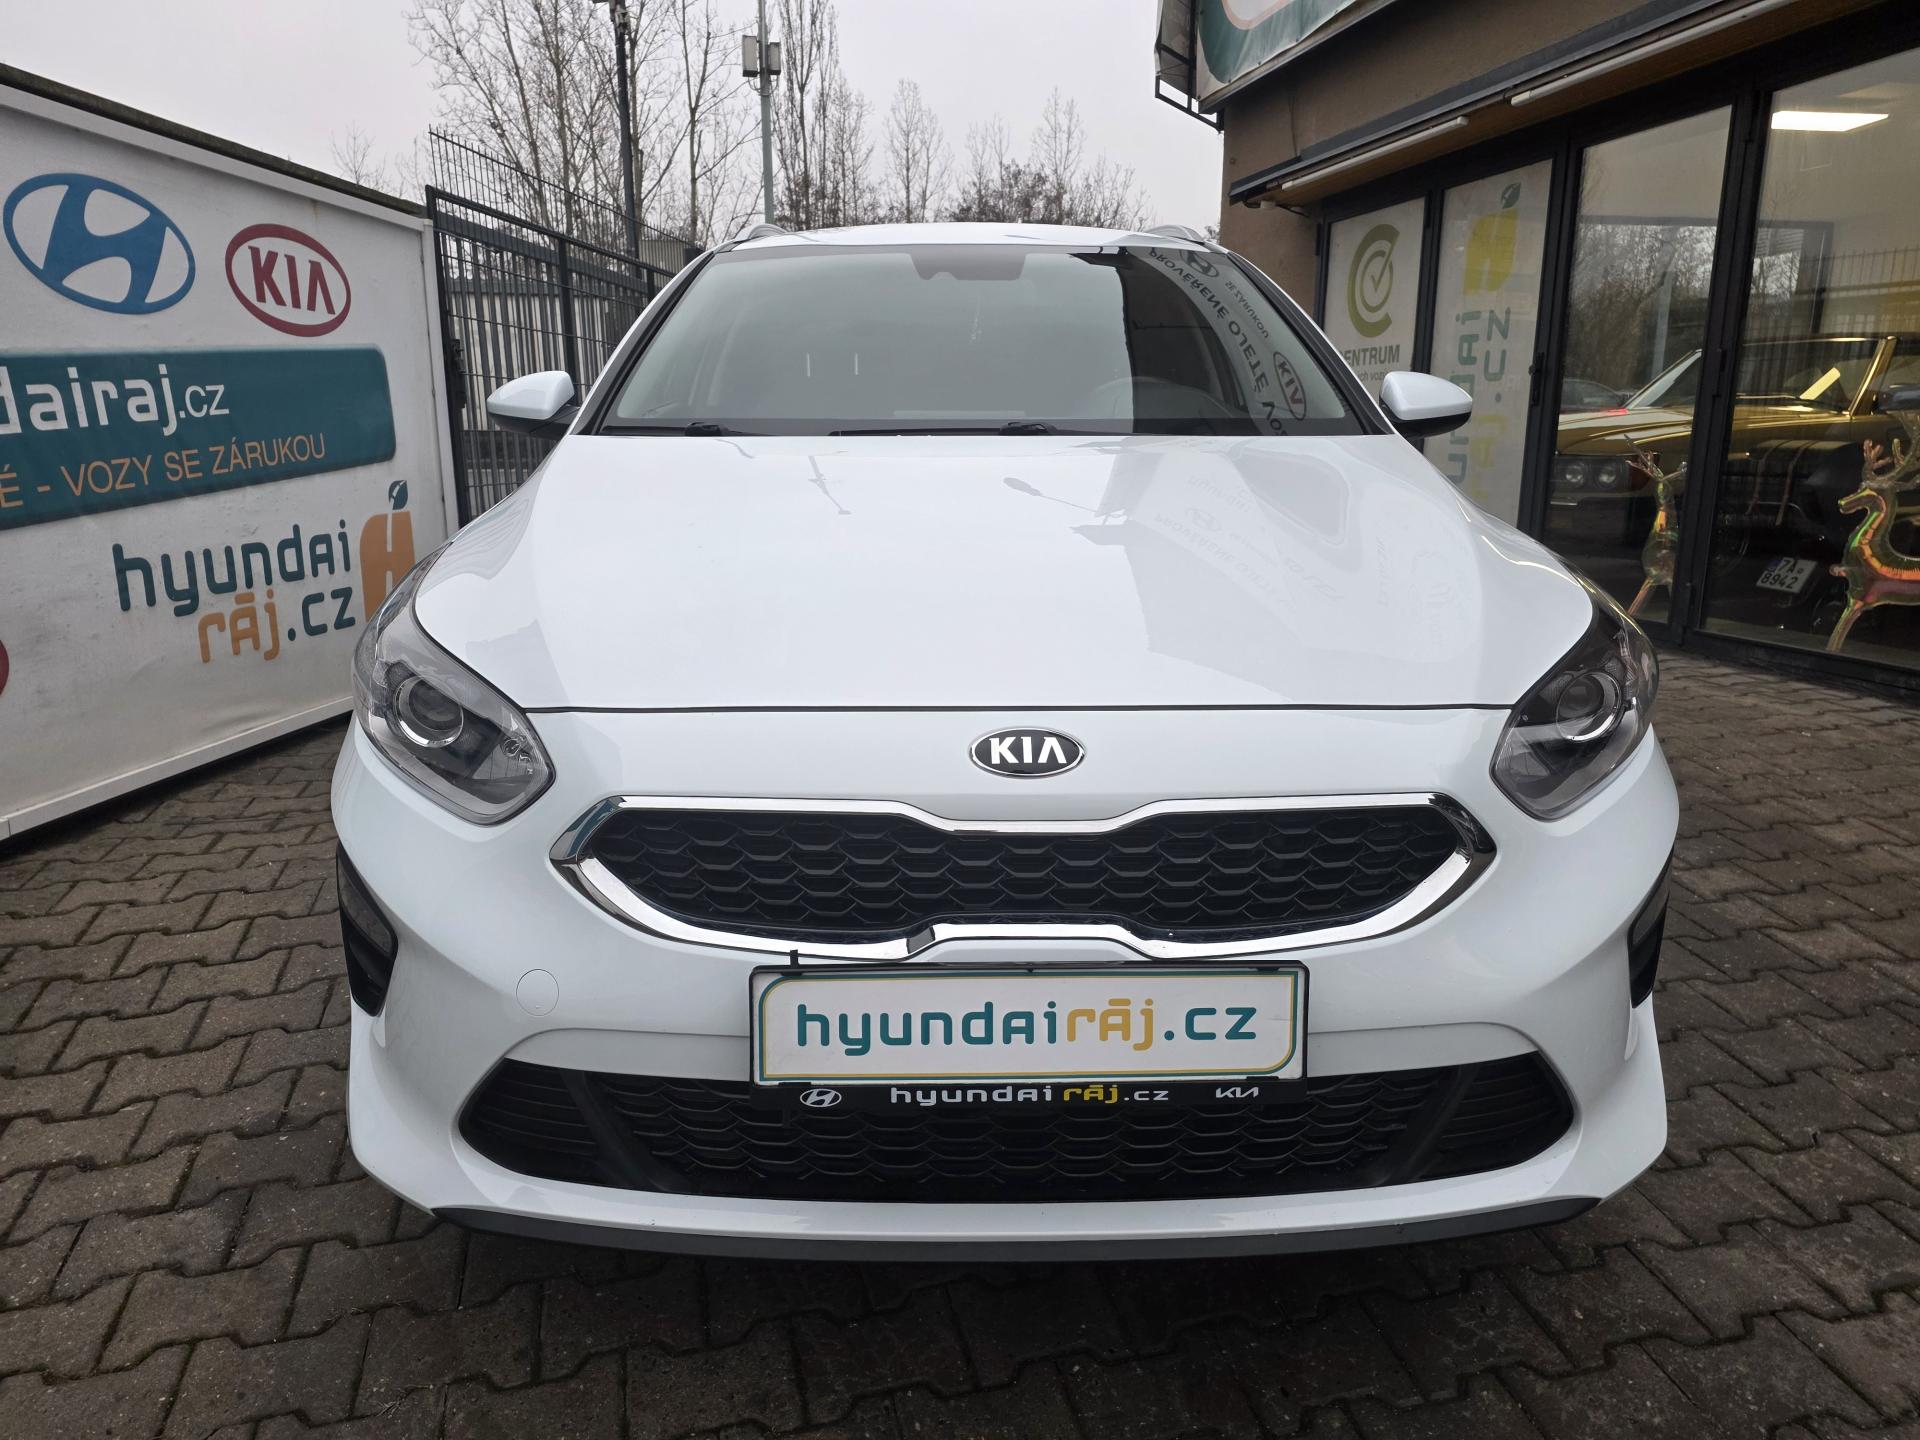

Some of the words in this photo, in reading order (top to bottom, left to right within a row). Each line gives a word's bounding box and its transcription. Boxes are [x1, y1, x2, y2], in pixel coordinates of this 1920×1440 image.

[247, 245, 335, 316] KIA
[60, 455, 152, 497] VOZY
[164, 449, 203, 481] SE
[208, 433, 325, 475] ZÁRUKOU
[988, 736, 1067, 764] KIA
